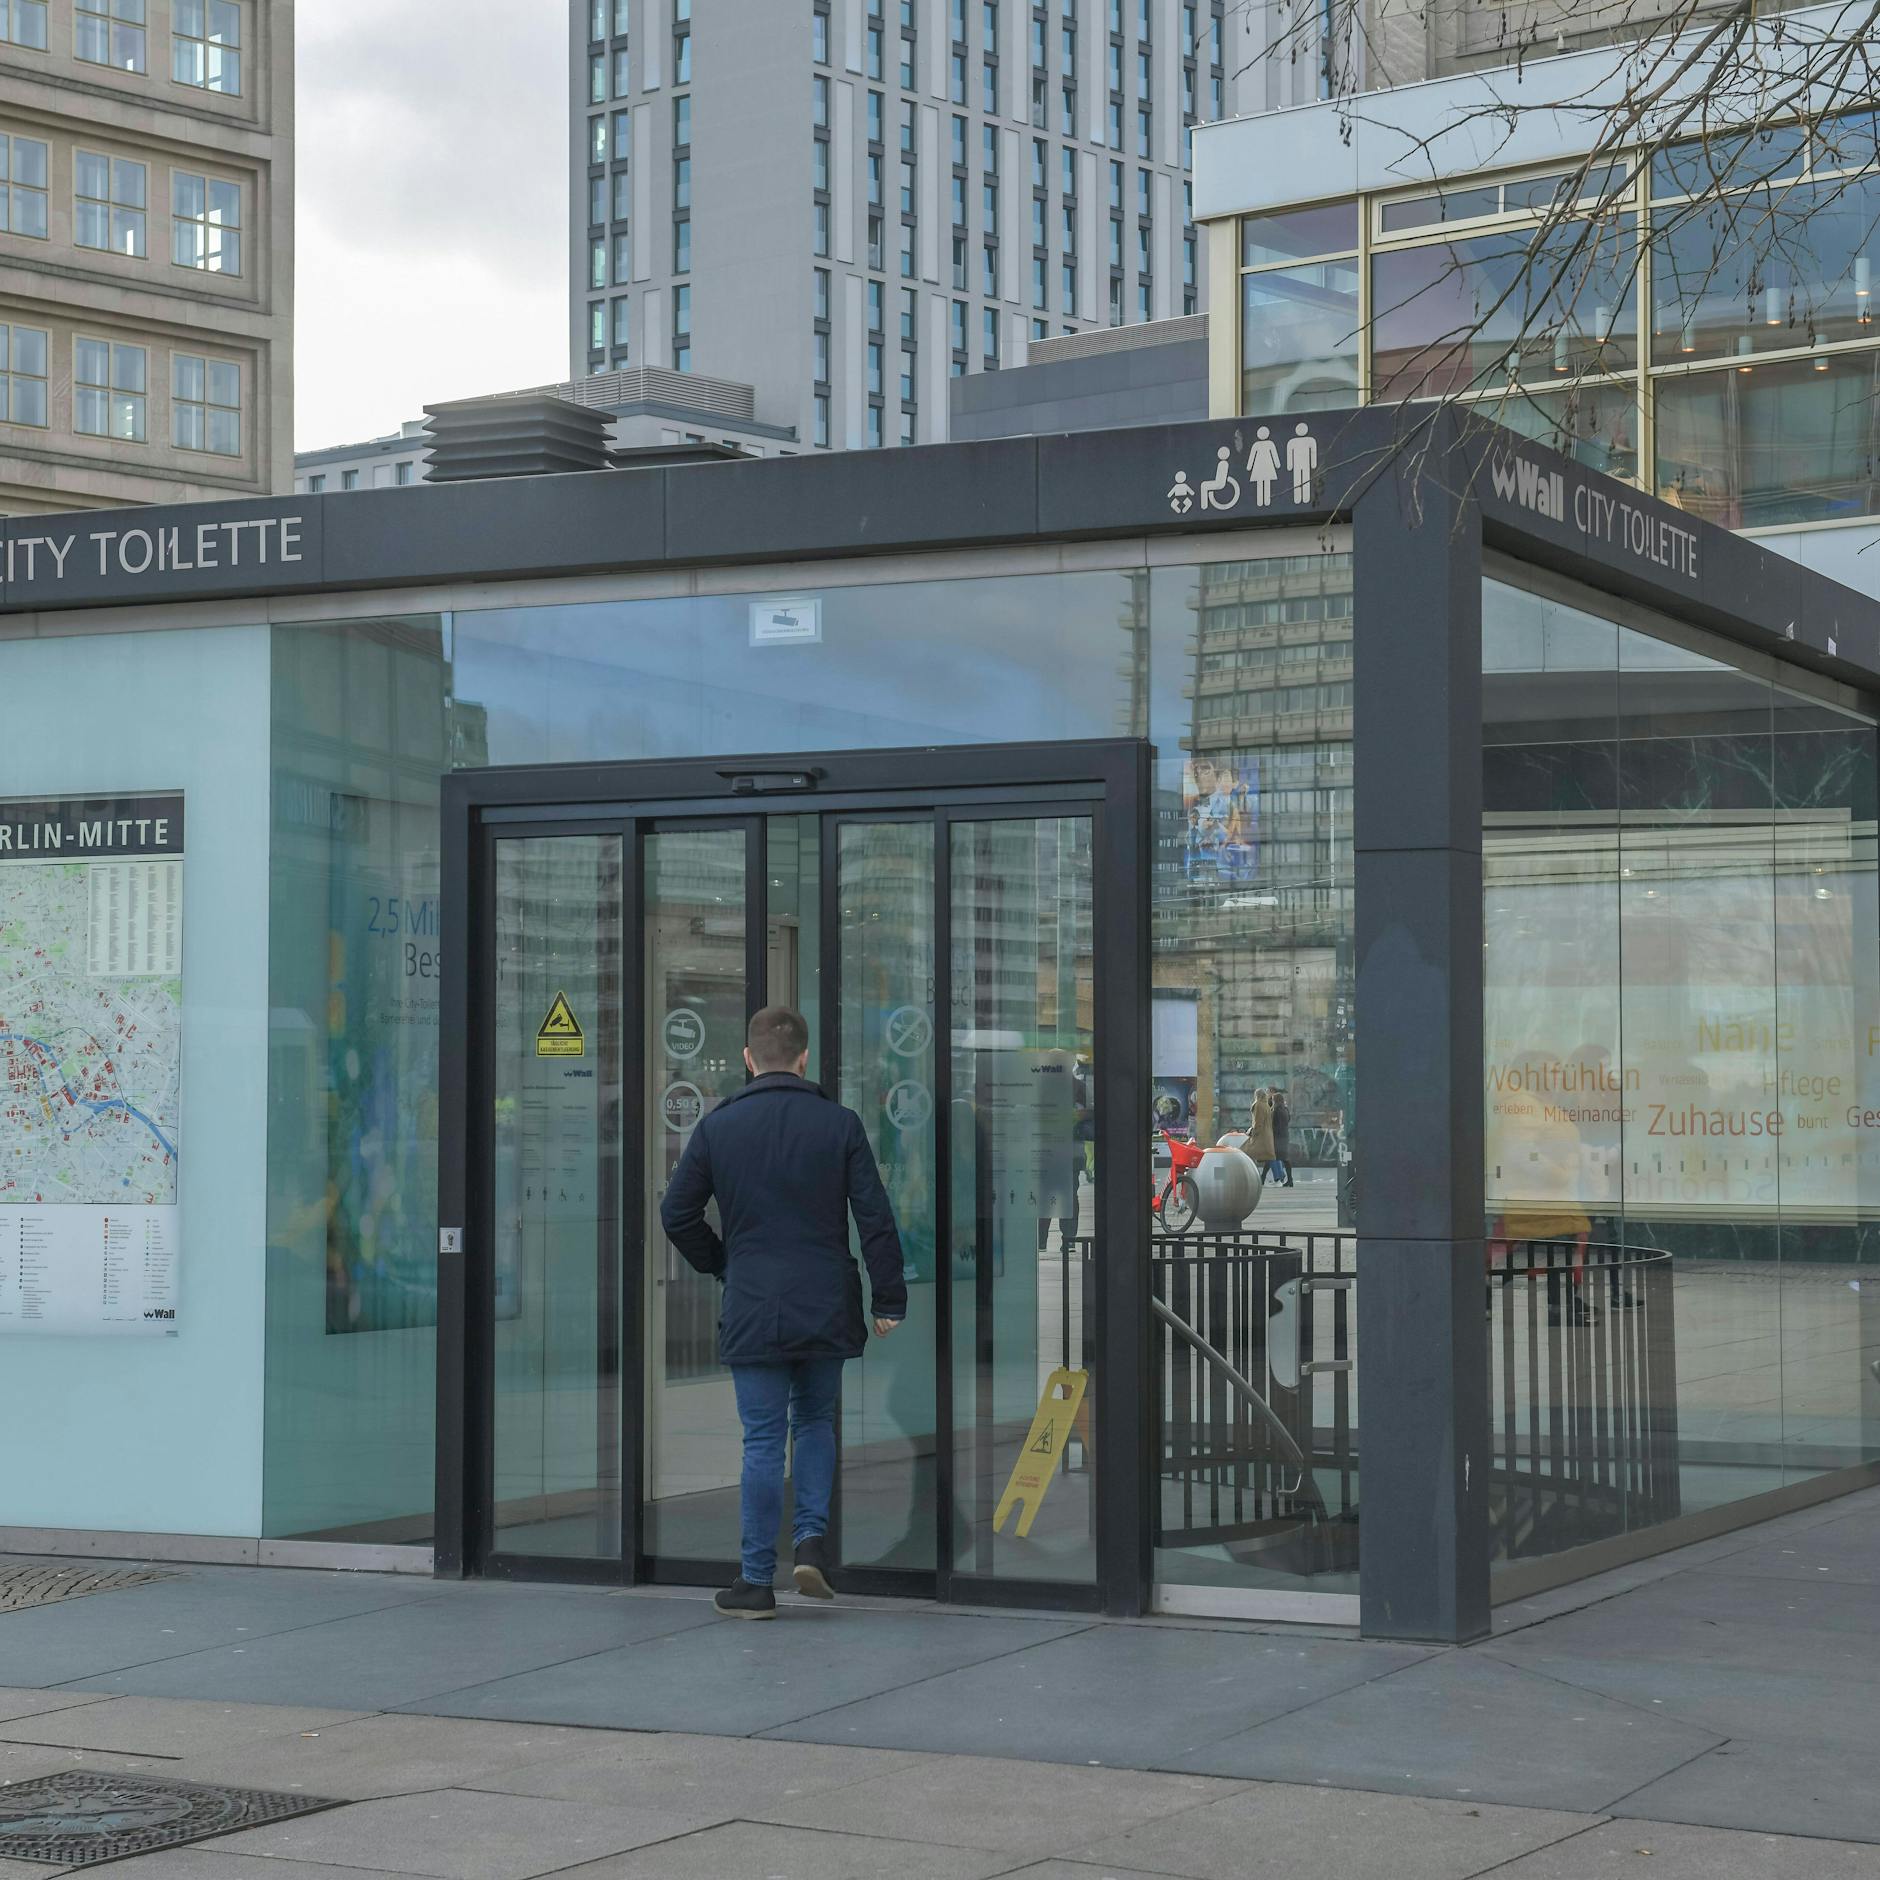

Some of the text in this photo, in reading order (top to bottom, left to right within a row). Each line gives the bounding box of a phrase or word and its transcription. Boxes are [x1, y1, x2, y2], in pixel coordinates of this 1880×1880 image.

[1516, 456, 1697, 579] Wall CITY TOILETTE
[0, 516, 303, 582] ITY TOILETTE
[0, 818, 169, 850] RLIN-MITTE
[671, 1042, 695, 1050] VIDEO
[1486, 1061, 1641, 1092] Wohlfühlen
[1762, 1067, 1842, 1102] Pflege
[666, 1098, 689, 1110] 0,50
[1544, 1105, 1638, 1122] Miteinander
[1647, 1103, 1785, 1136] Zuhause
[1797, 1113, 1830, 1130] bunt
[154, 1309, 175, 1319] Wall
